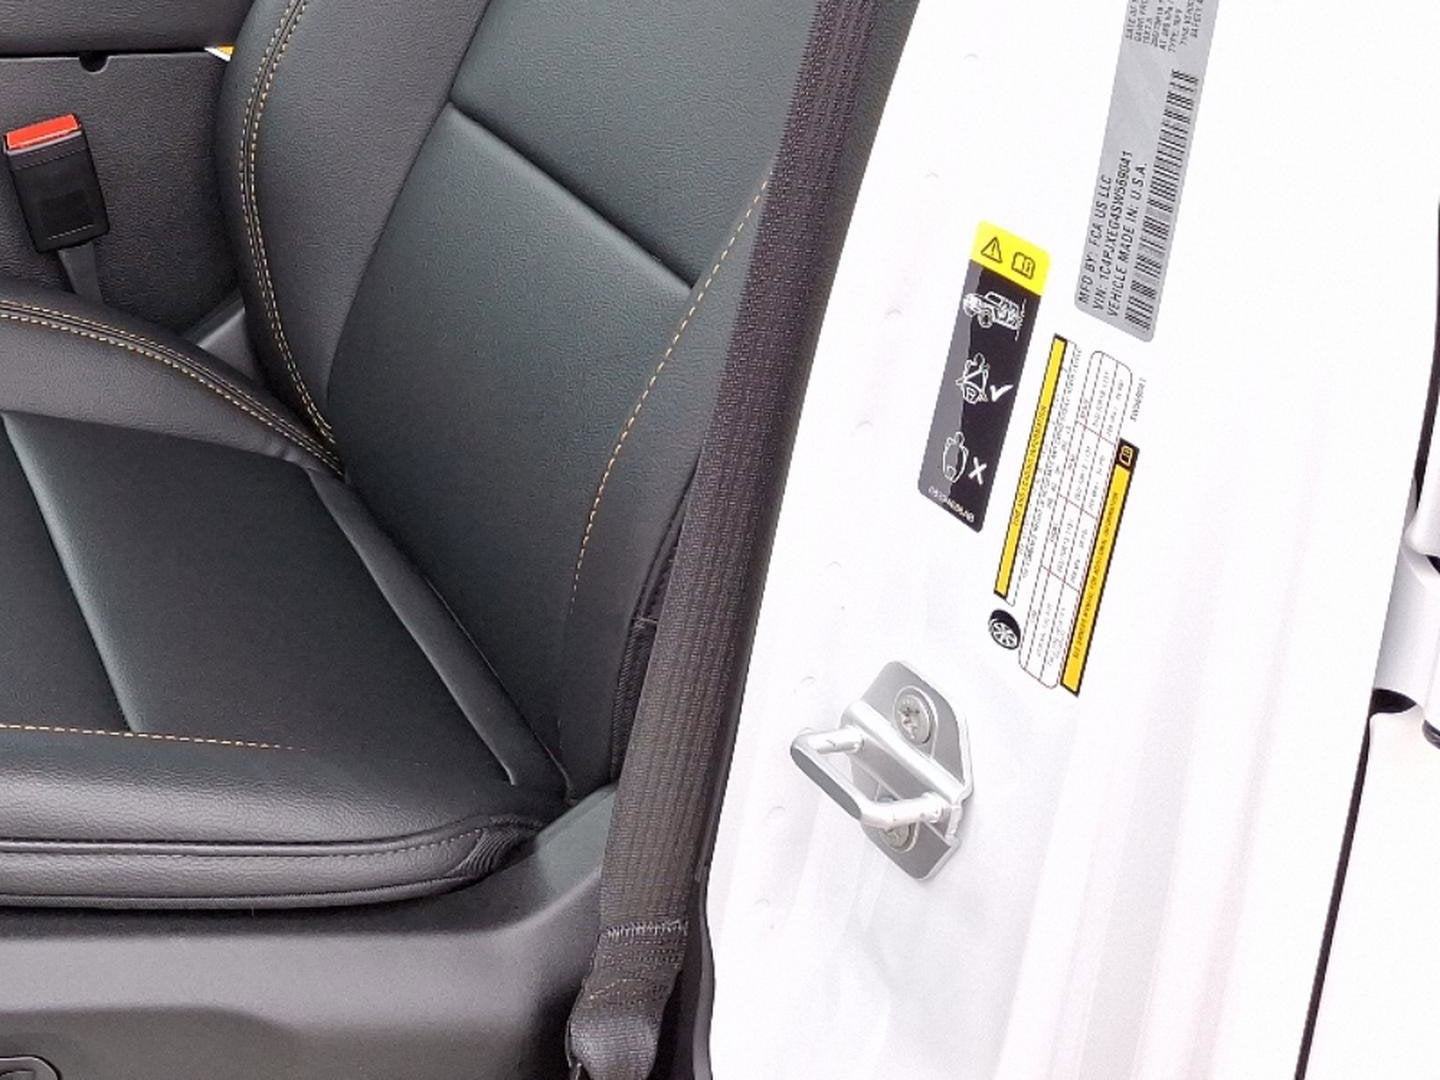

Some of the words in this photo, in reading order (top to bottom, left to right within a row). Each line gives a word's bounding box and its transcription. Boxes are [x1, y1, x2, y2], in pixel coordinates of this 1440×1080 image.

[1098, 173, 1111, 198] LLC
[1094, 199, 1106, 219] US
[1089, 220, 1102, 246] FCA
[1107, 264, 1127, 318] VEHICLE
[1118, 224, 1134, 263] MADE
[1131, 160, 1147, 201] U.S.A.
[1079, 274, 1093, 304] MFD
[1093, 283, 1107, 311] VIN:
